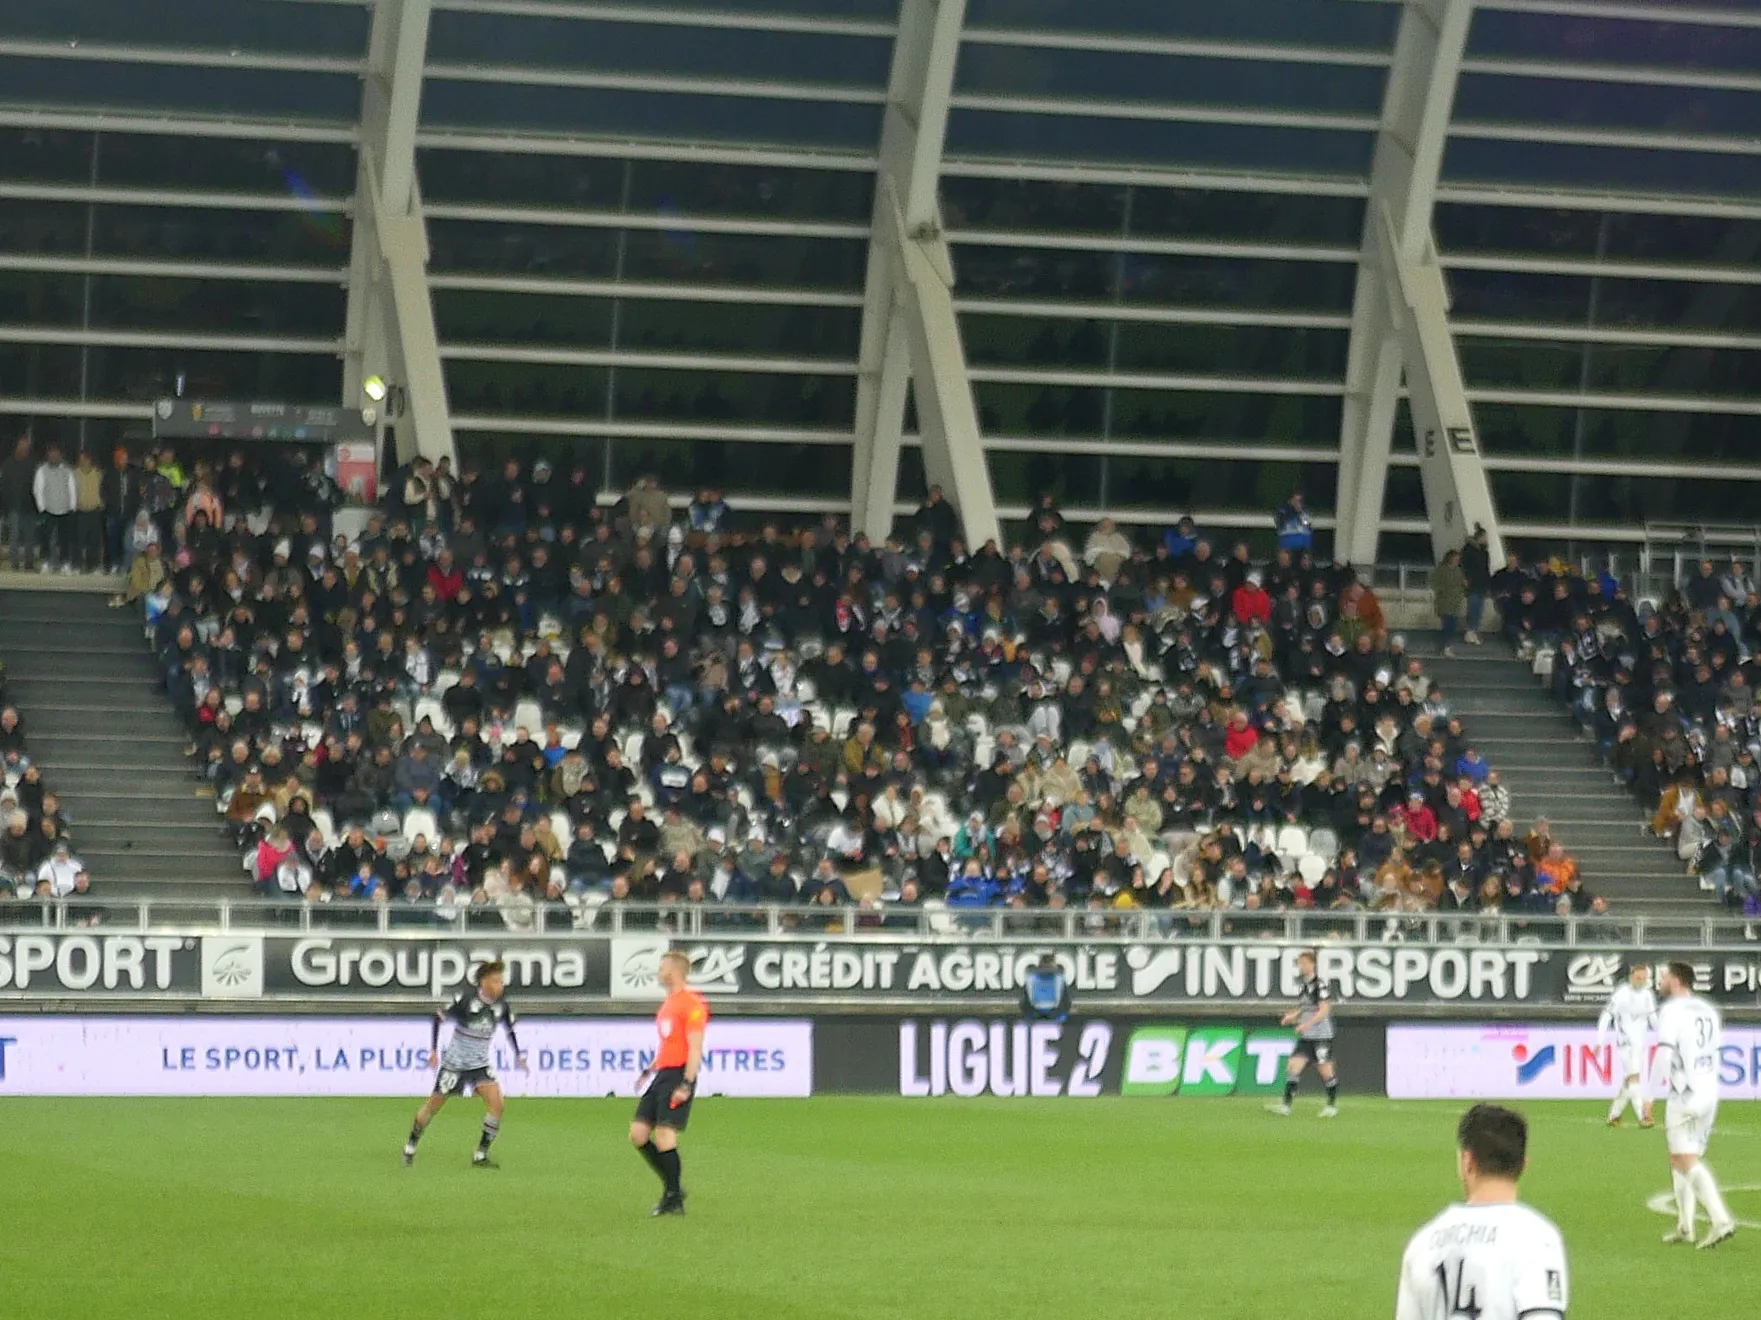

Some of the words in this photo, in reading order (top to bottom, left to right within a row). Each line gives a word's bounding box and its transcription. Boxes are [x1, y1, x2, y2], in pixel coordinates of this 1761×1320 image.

[290, 938, 585, 997] Groupama
[753, 942, 898, 990] CRÉDIT
[908, 949, 1118, 991] AGRICOLE
[1185, 946, 1538, 999] INTERSPORT
[162, 1048, 196, 1070] LE
[205, 1048, 305, 1075] SPORT,
[315, 1048, 351, 1071] LA
[359, 1048, 433, 1072] PLUS
[538, 1049, 592, 1072] DES
[600, 1049, 786, 1072] RENNTRES
[900, 1021, 1062, 1097] LIGUE
[1068, 1022, 1113, 1097] 2
[1128, 1038, 1297, 1085] BKT
